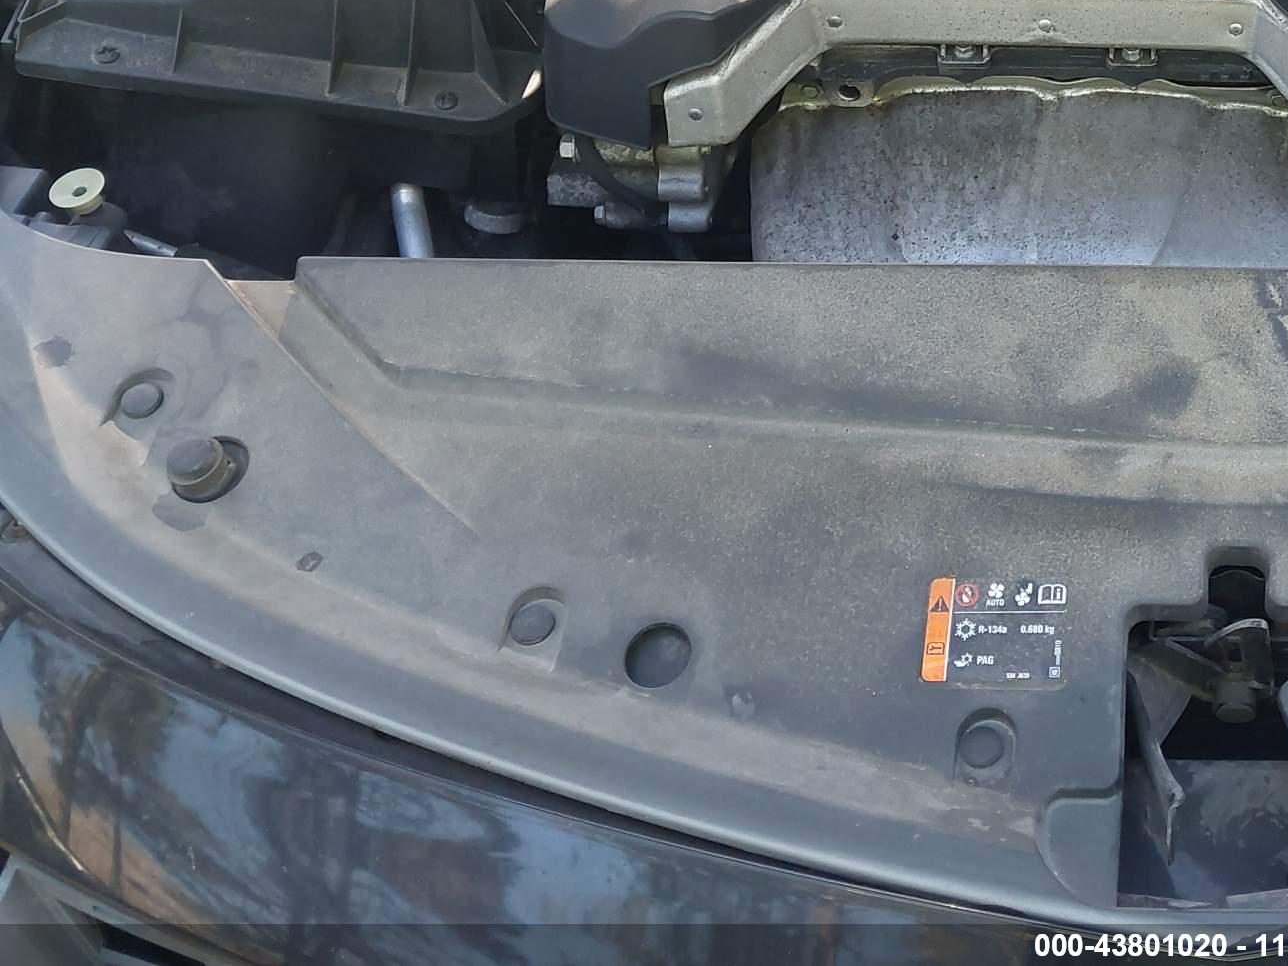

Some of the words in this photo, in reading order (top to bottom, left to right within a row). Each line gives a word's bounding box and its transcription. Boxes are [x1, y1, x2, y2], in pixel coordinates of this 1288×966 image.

[978, 625, 1007, 634] R-134a
[1045, 625, 1055, 634] kg
[977, 655, 994, 665] PAG
